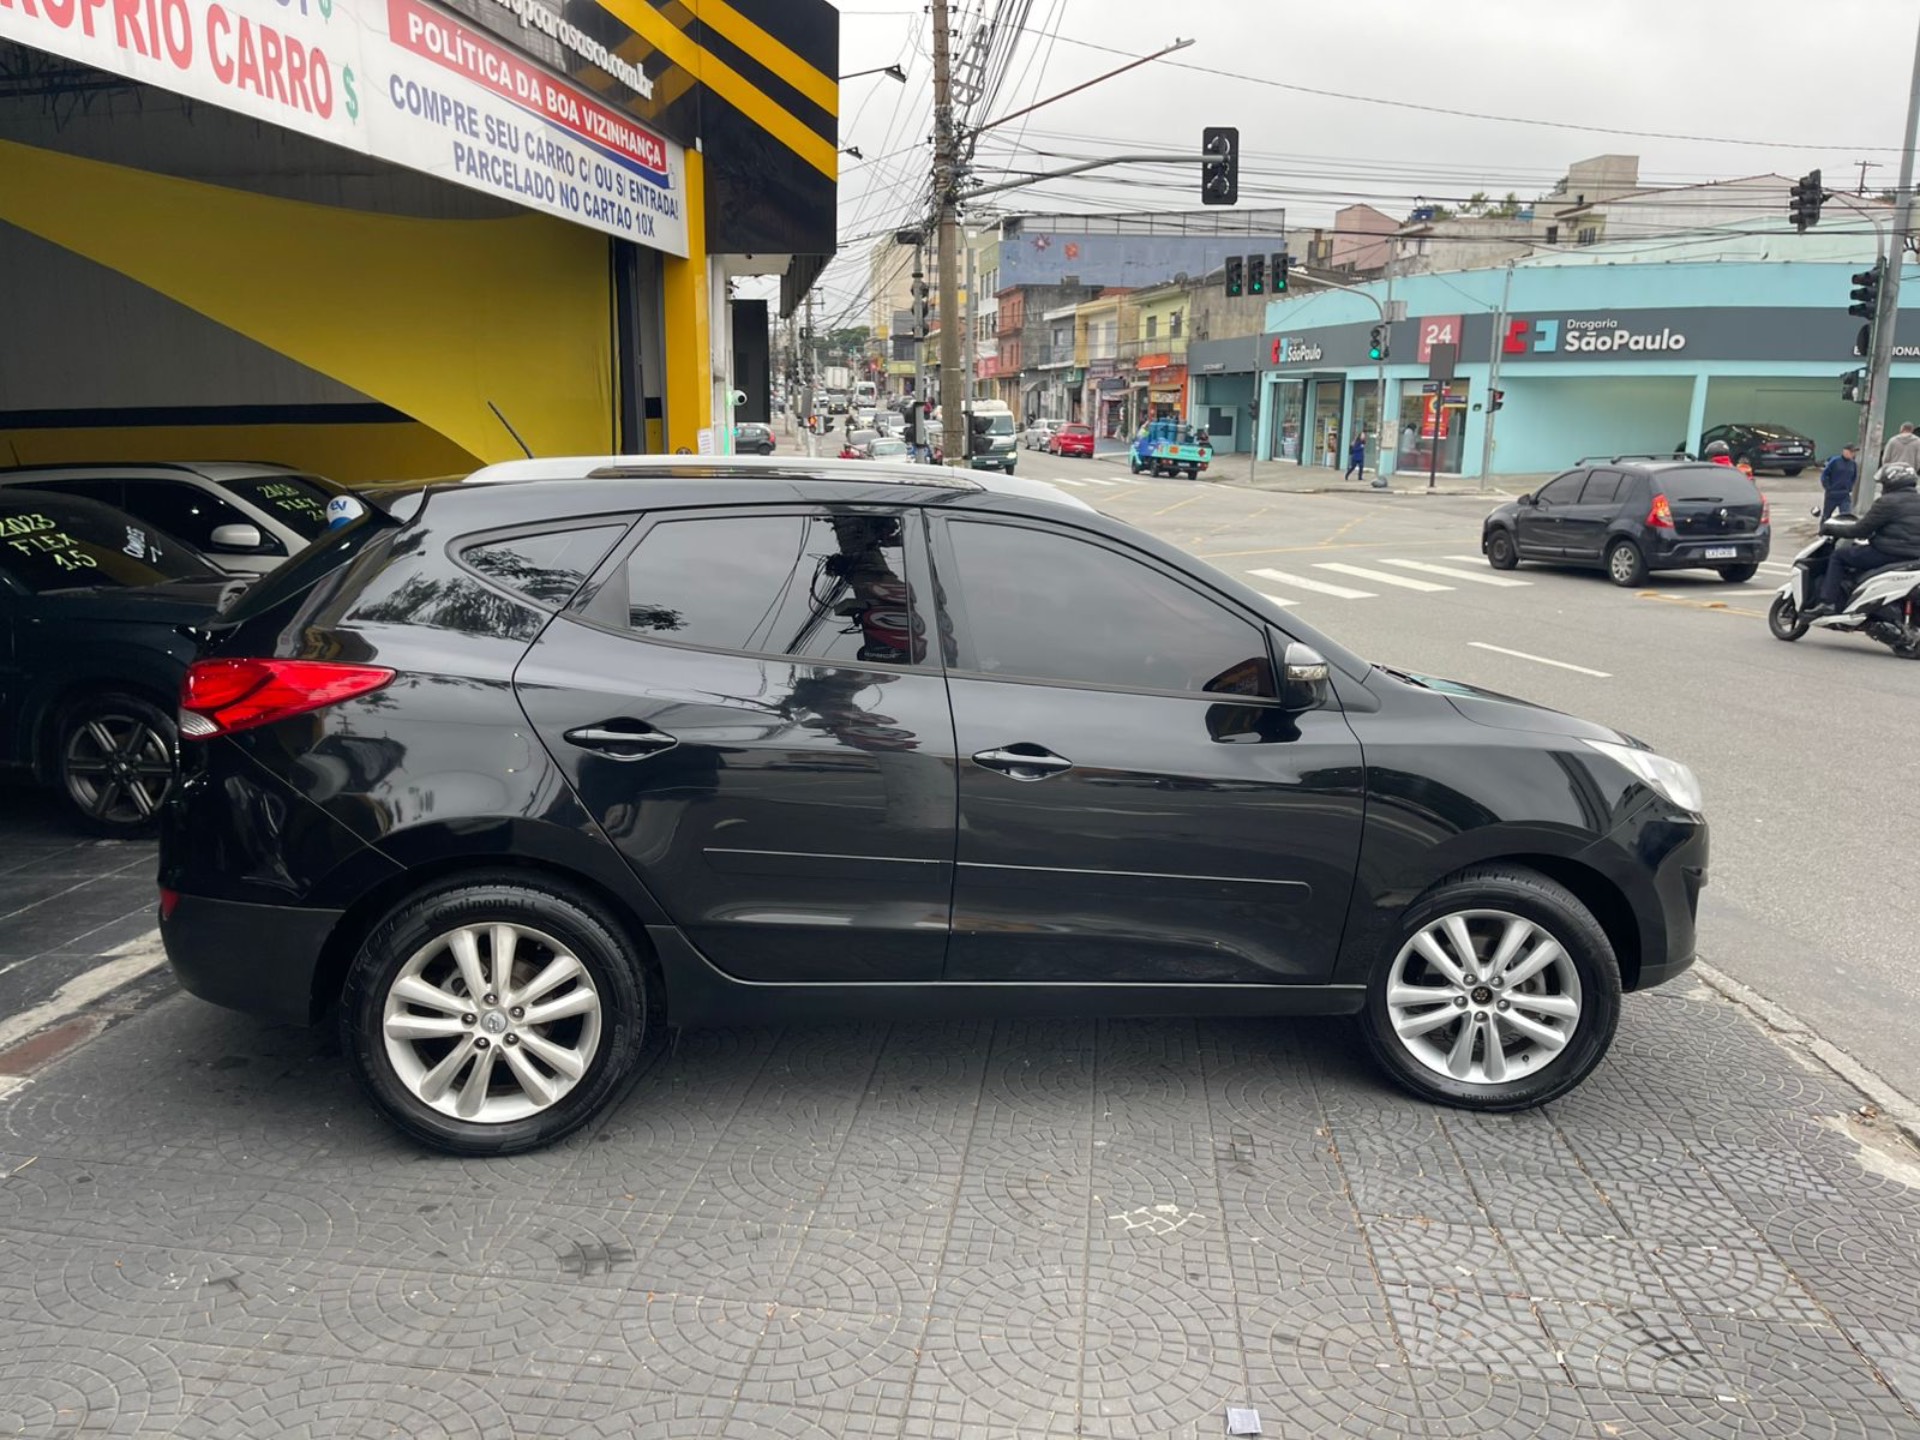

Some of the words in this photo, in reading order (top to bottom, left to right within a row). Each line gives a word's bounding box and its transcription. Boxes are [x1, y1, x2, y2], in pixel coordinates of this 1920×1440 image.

[206, 3, 333, 120] CARRO
[408, 12, 513, 91] POLÍTICA
[516, 69, 543, 107] DA
[546, 86, 580, 126] BOA
[581, 105, 662, 166] VIZINHANÇA
[389, 74, 480, 139] COMPRE
[485, 114, 520, 154] SEU
[525, 131, 575, 178] CARRO
[595, 163, 613, 192] OU
[629, 179, 679, 220] ENTRADA!
[453, 140, 555, 203] PARCELADO
[559, 181, 579, 213] NO
[635, 211, 655, 238] 10X
[1425, 324, 1452, 344] 24
[1564, 328, 1686, 352] SãoPaulo
[1566, 318, 1618, 330] Drogaria
[8, 533, 79, 556] FLEX
